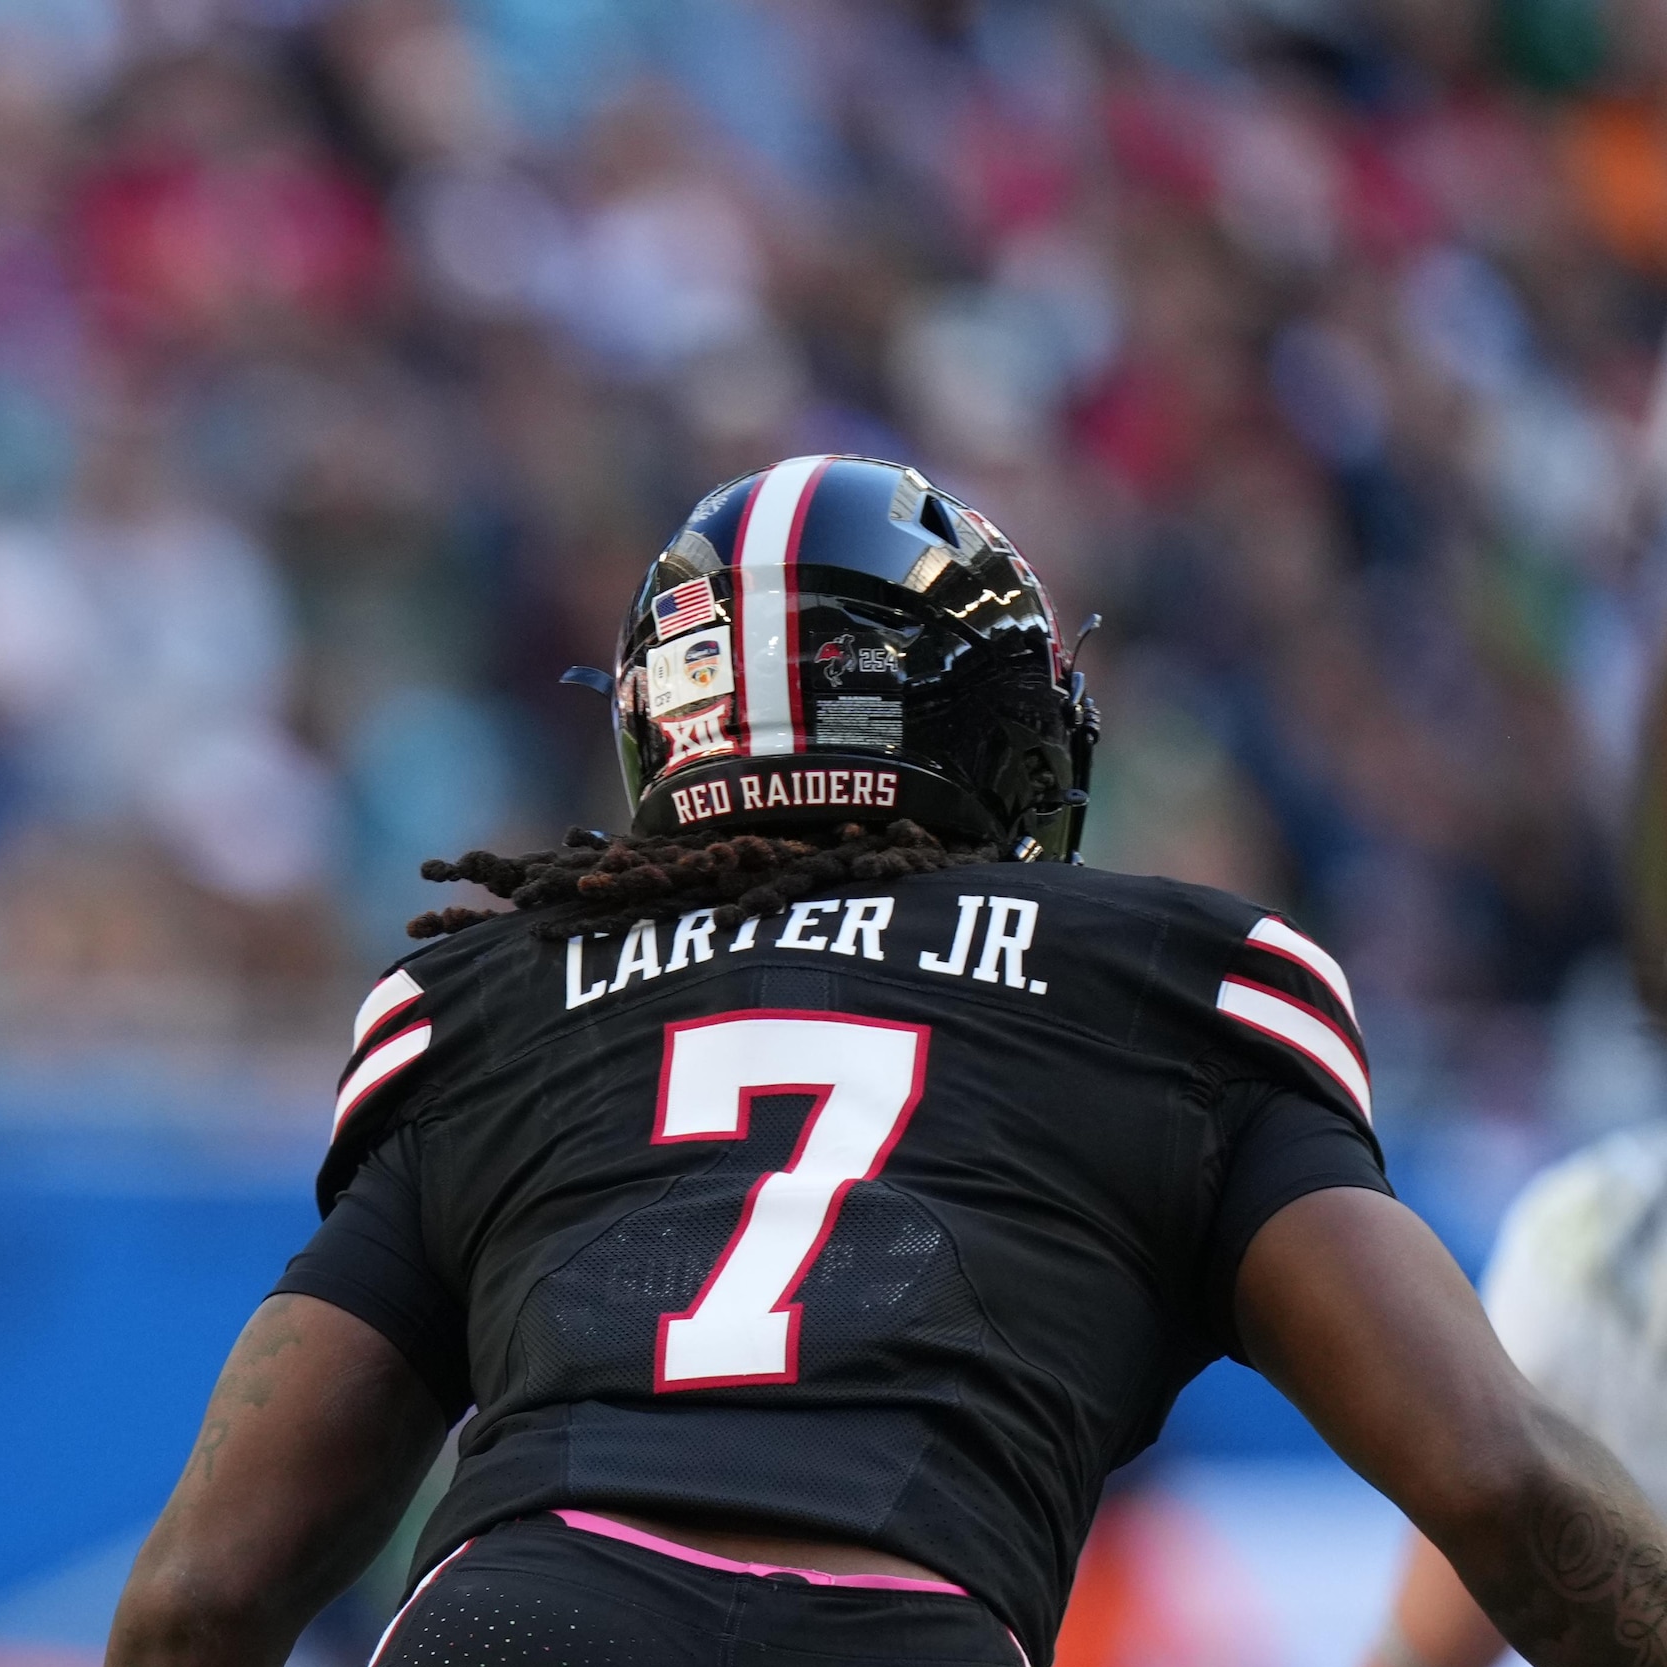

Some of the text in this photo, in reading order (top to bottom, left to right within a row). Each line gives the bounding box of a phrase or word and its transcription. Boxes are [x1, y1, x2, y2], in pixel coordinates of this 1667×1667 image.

[671, 770, 899, 825] RED RAIDERS
[919, 895, 1048, 996] JR.
[650, 1008, 931, 1393] 7
